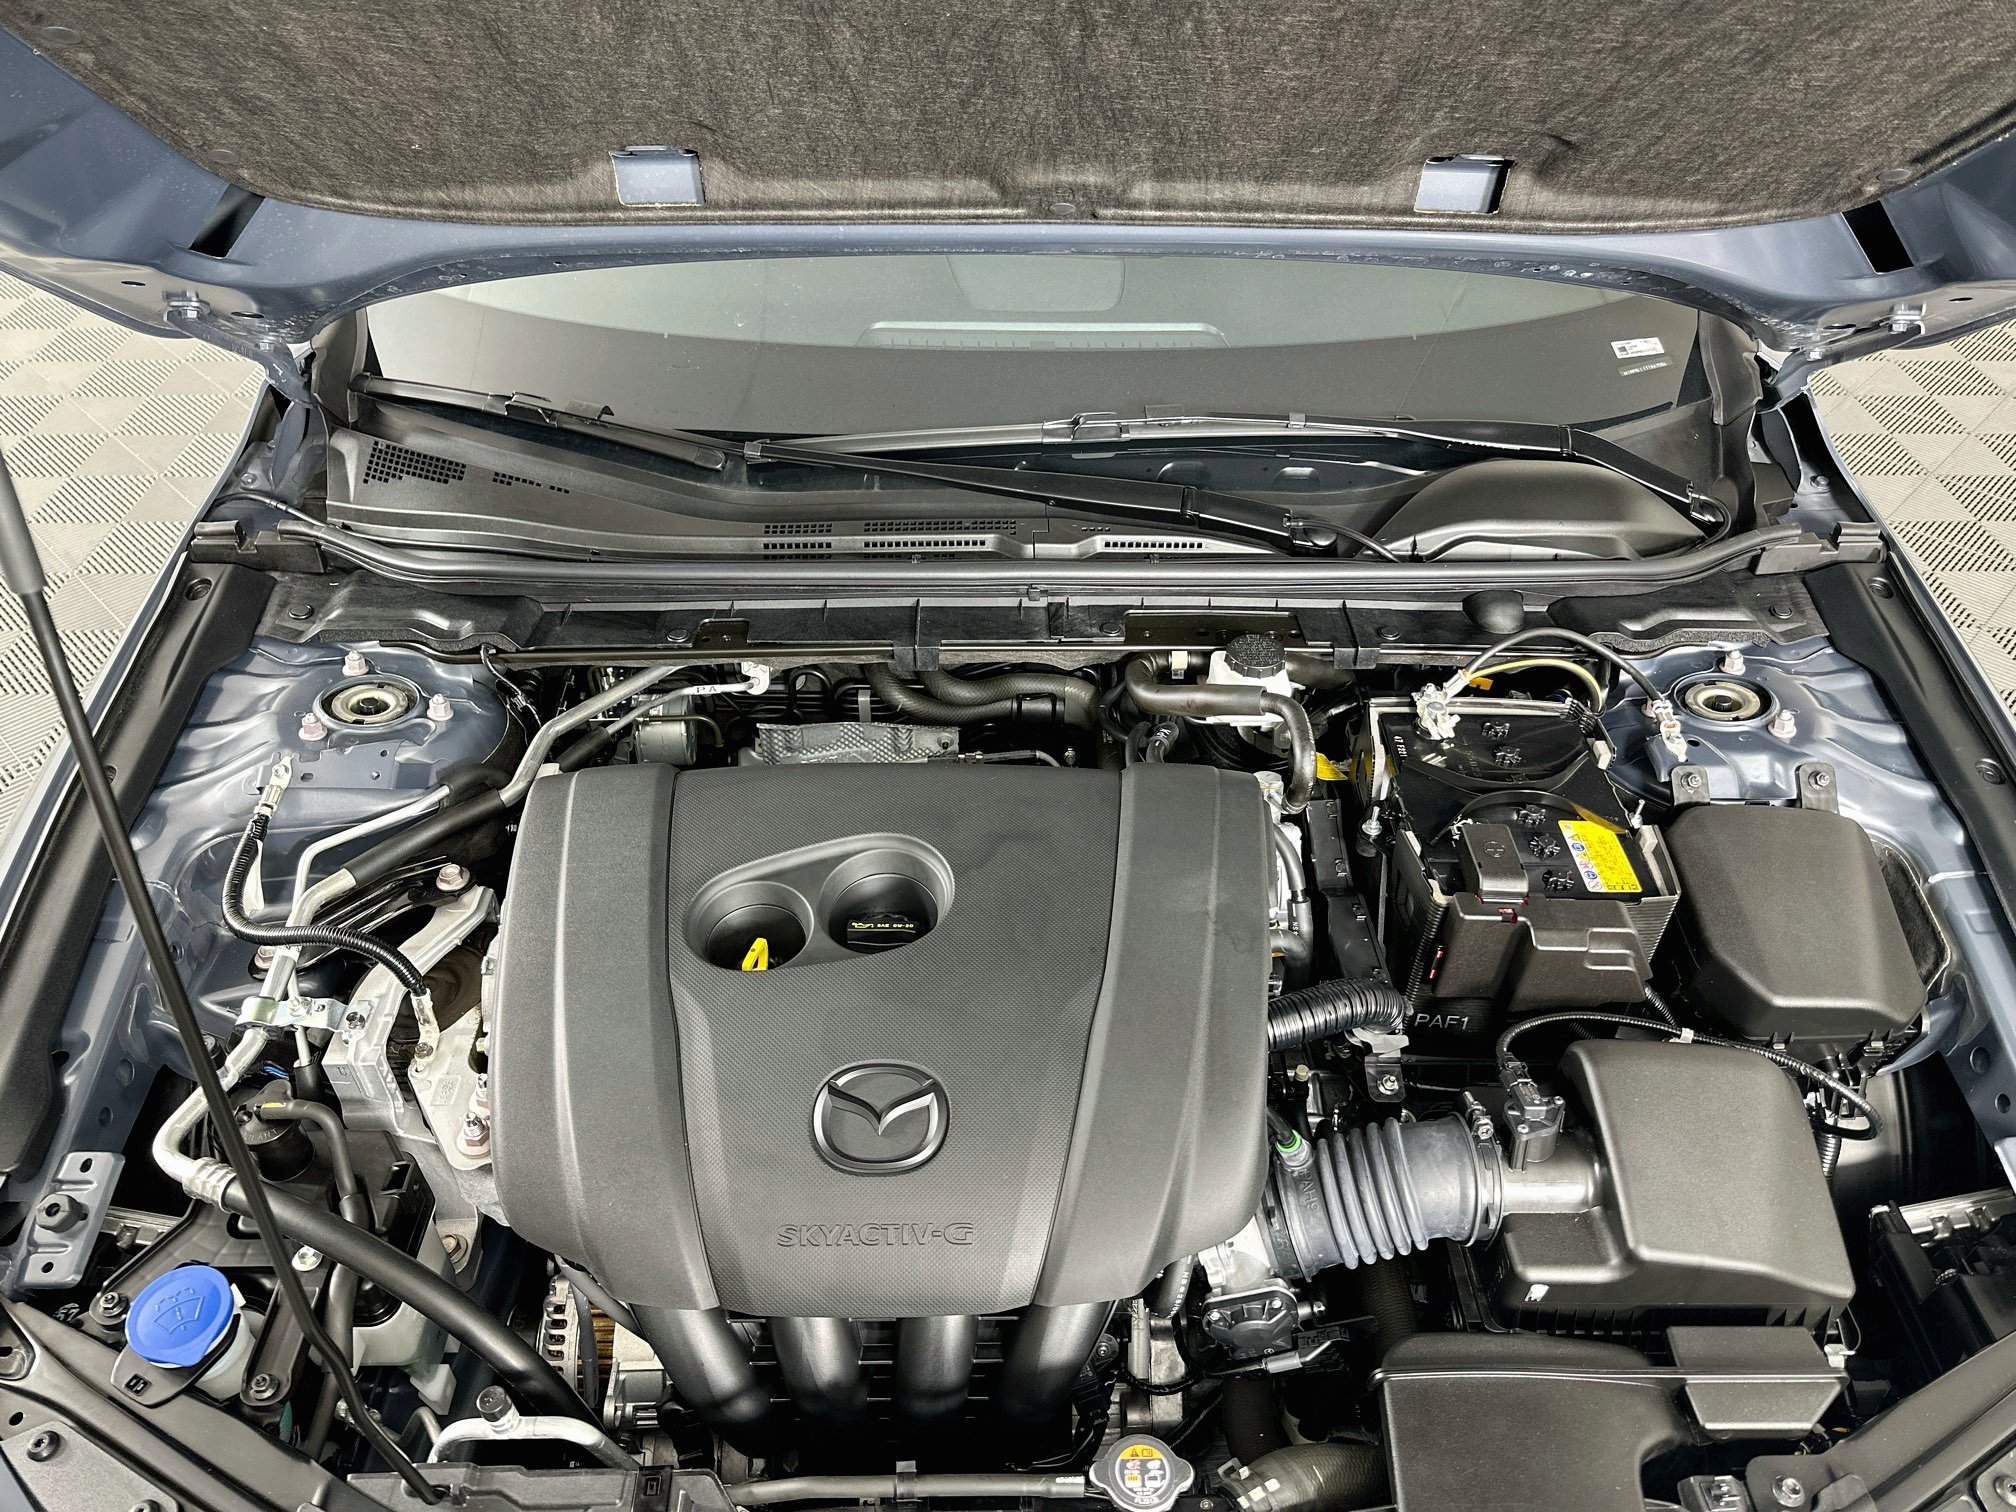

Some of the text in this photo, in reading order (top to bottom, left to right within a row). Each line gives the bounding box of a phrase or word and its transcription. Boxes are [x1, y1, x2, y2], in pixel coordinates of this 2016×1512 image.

[1413, 1013, 1469, 1030] PAF1
[1299, 1169, 1320, 1212] PAH9
[776, 1222, 974, 1247] SKYACTIV-G
